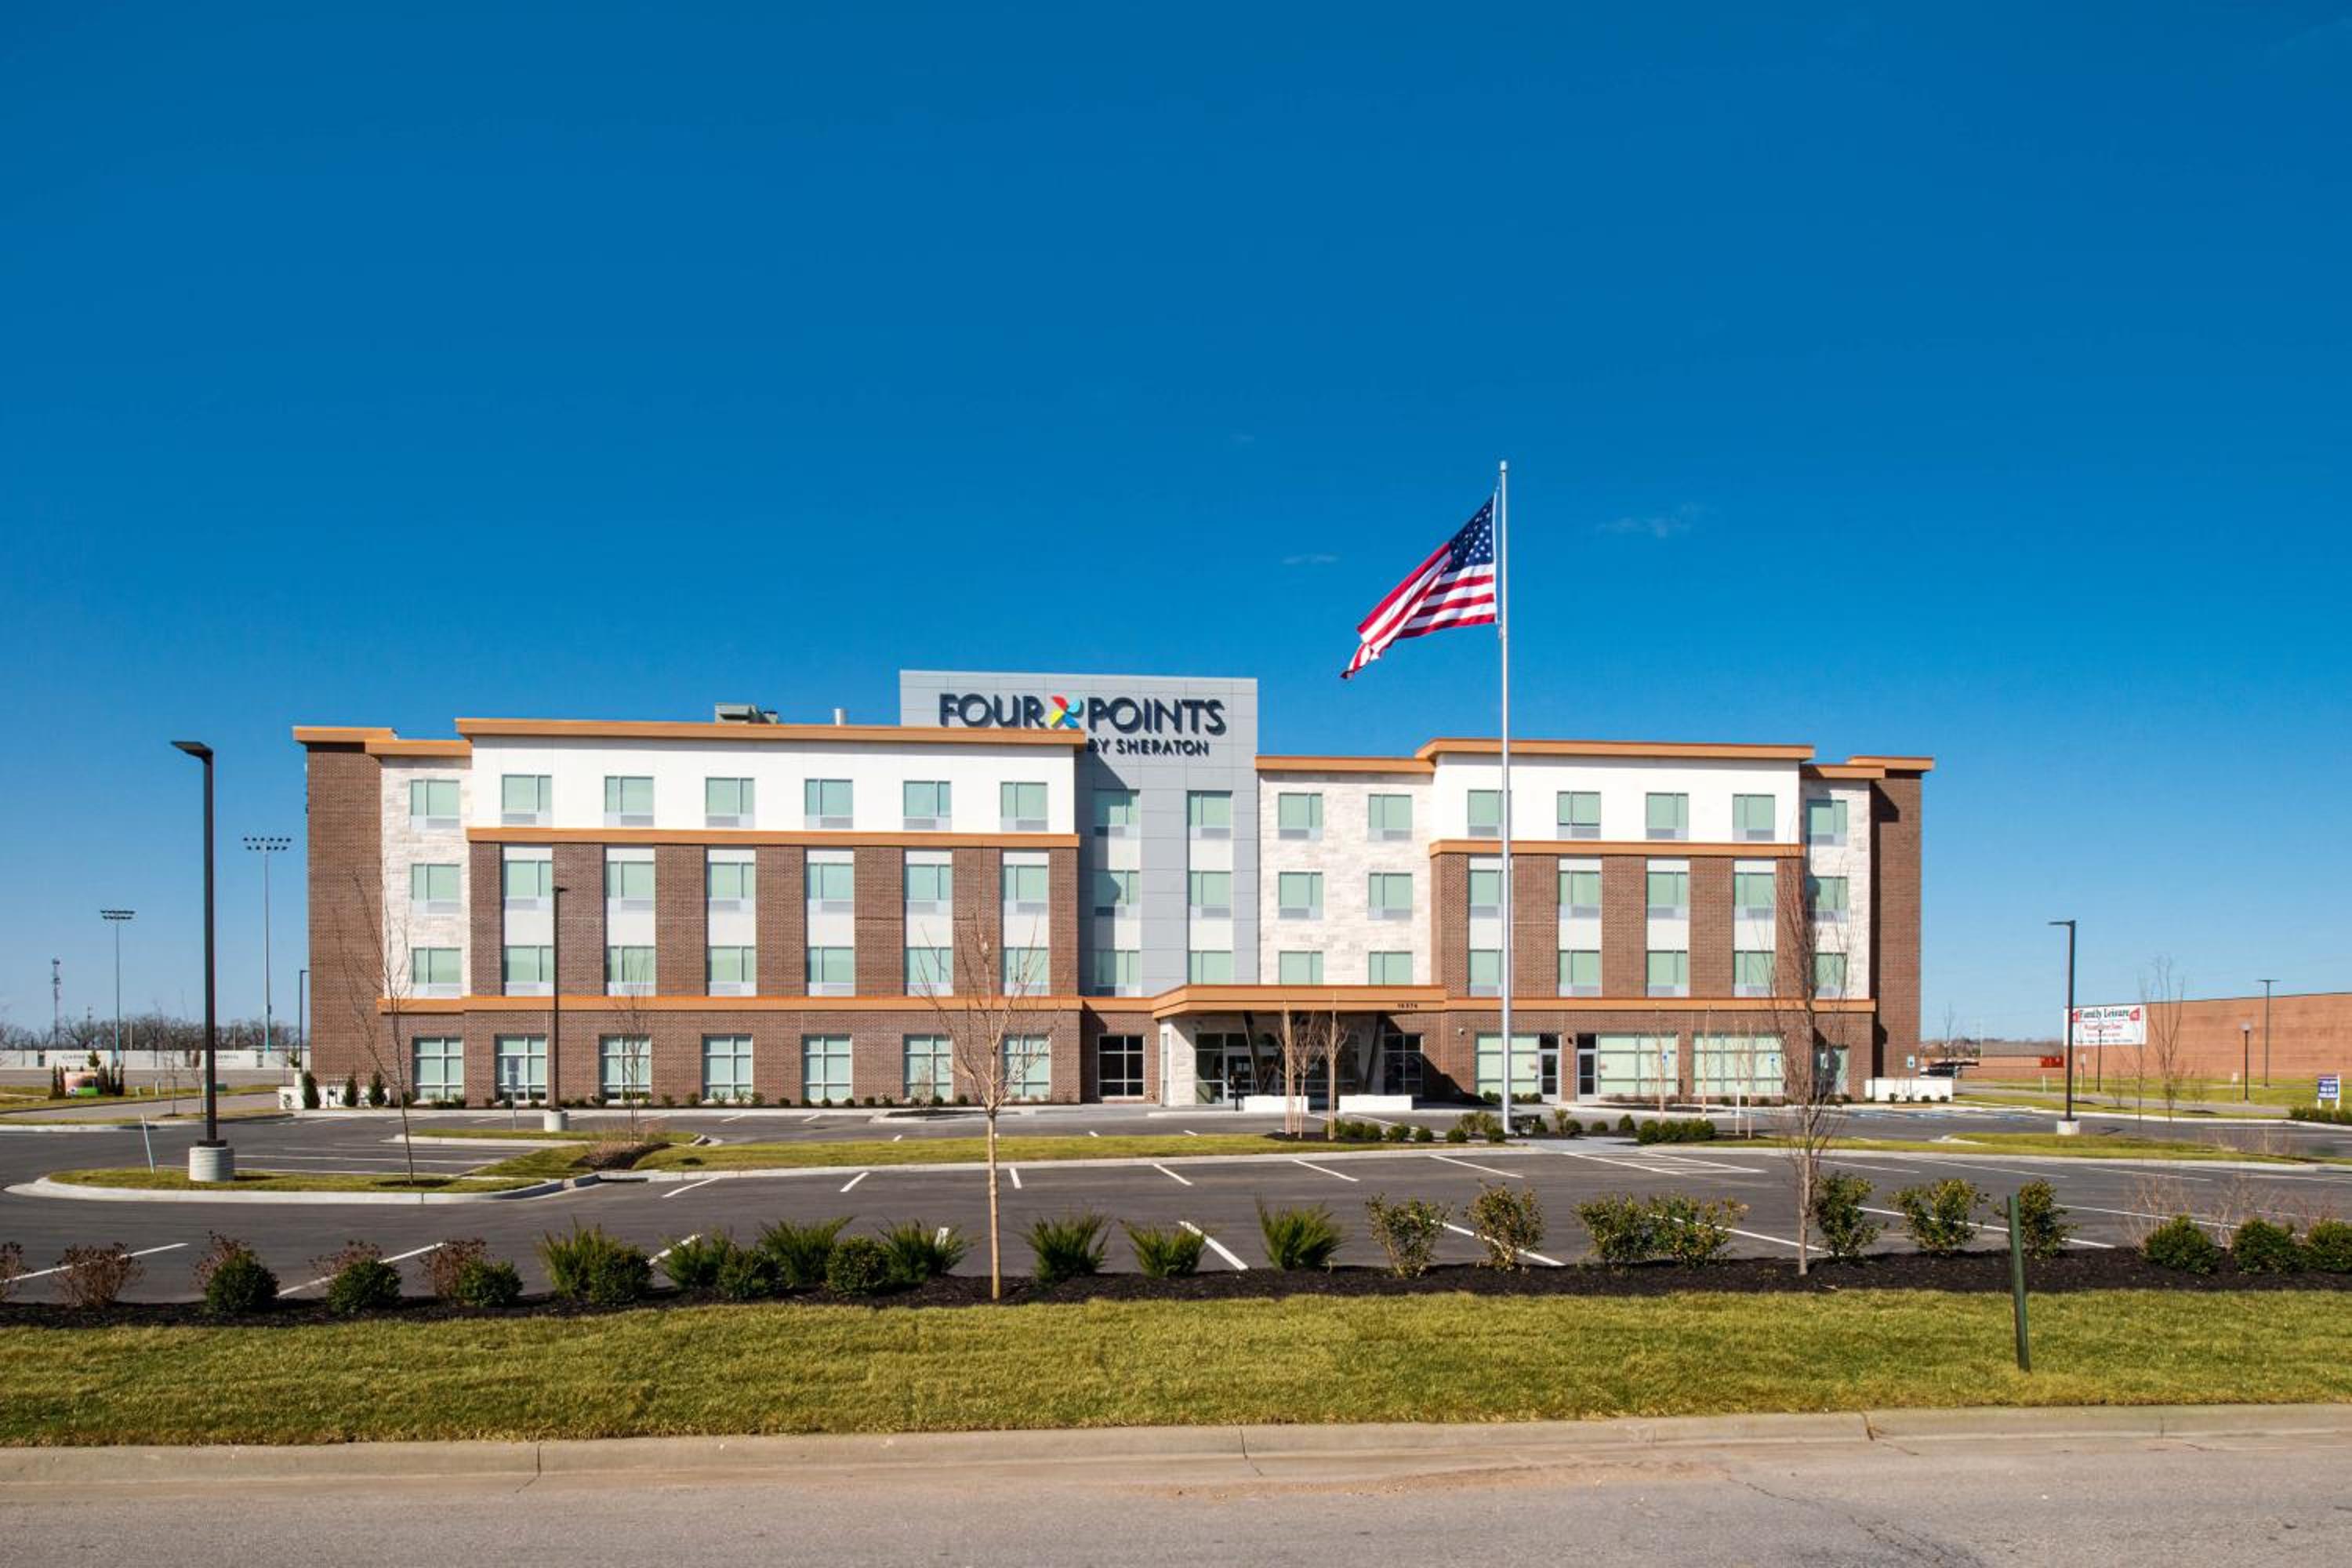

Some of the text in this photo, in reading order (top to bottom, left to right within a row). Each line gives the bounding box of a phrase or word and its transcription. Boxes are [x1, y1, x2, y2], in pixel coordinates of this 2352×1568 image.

[938, 693, 1227, 735] FOUR POINTS
[1087, 738, 1210, 756] BY SHERATON
[2079, 1007, 2129, 1020] Family Leisure
